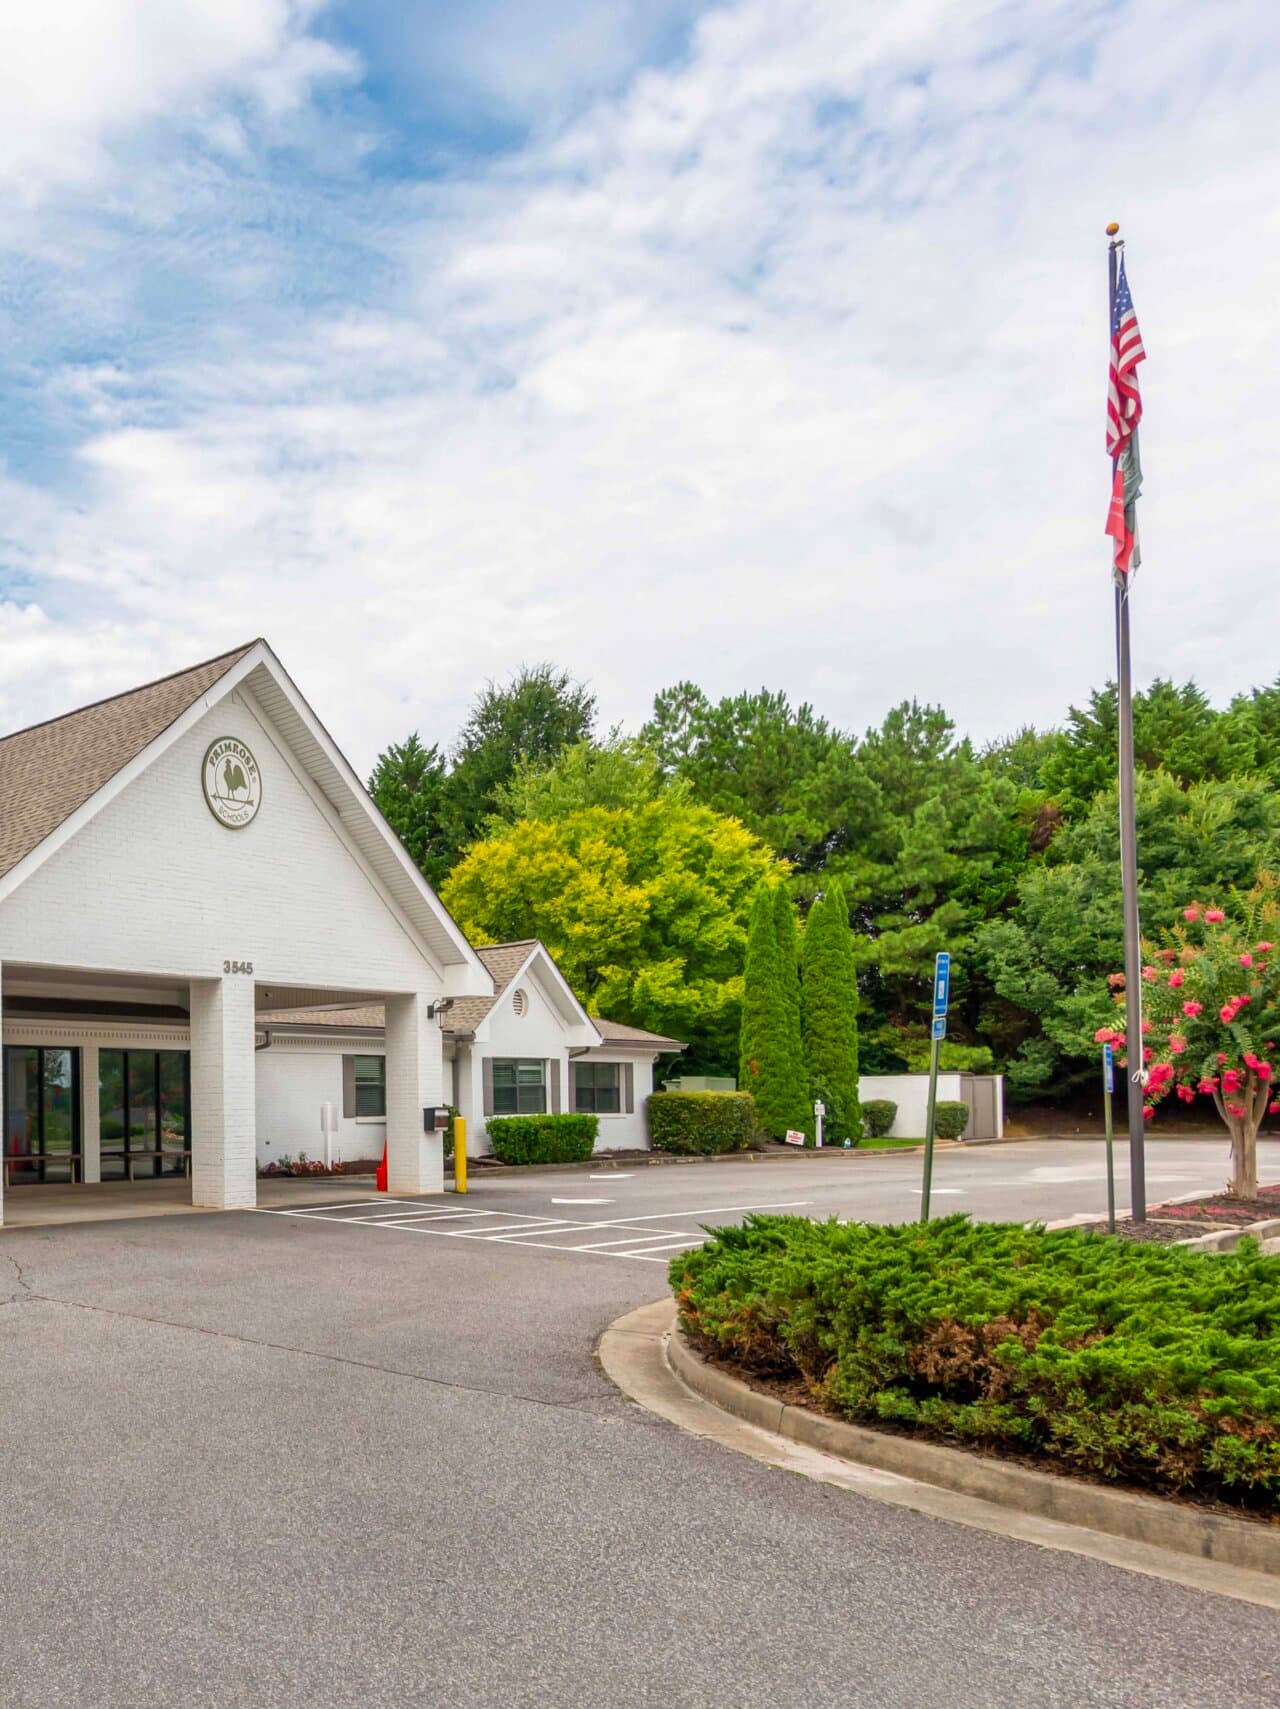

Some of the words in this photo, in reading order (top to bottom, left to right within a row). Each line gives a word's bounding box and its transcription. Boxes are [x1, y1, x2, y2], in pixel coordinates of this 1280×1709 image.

[209, 742, 257, 776] PRIMROSE
[218, 807, 250, 823] SCHOOLS
[223, 959, 254, 975] 3545
